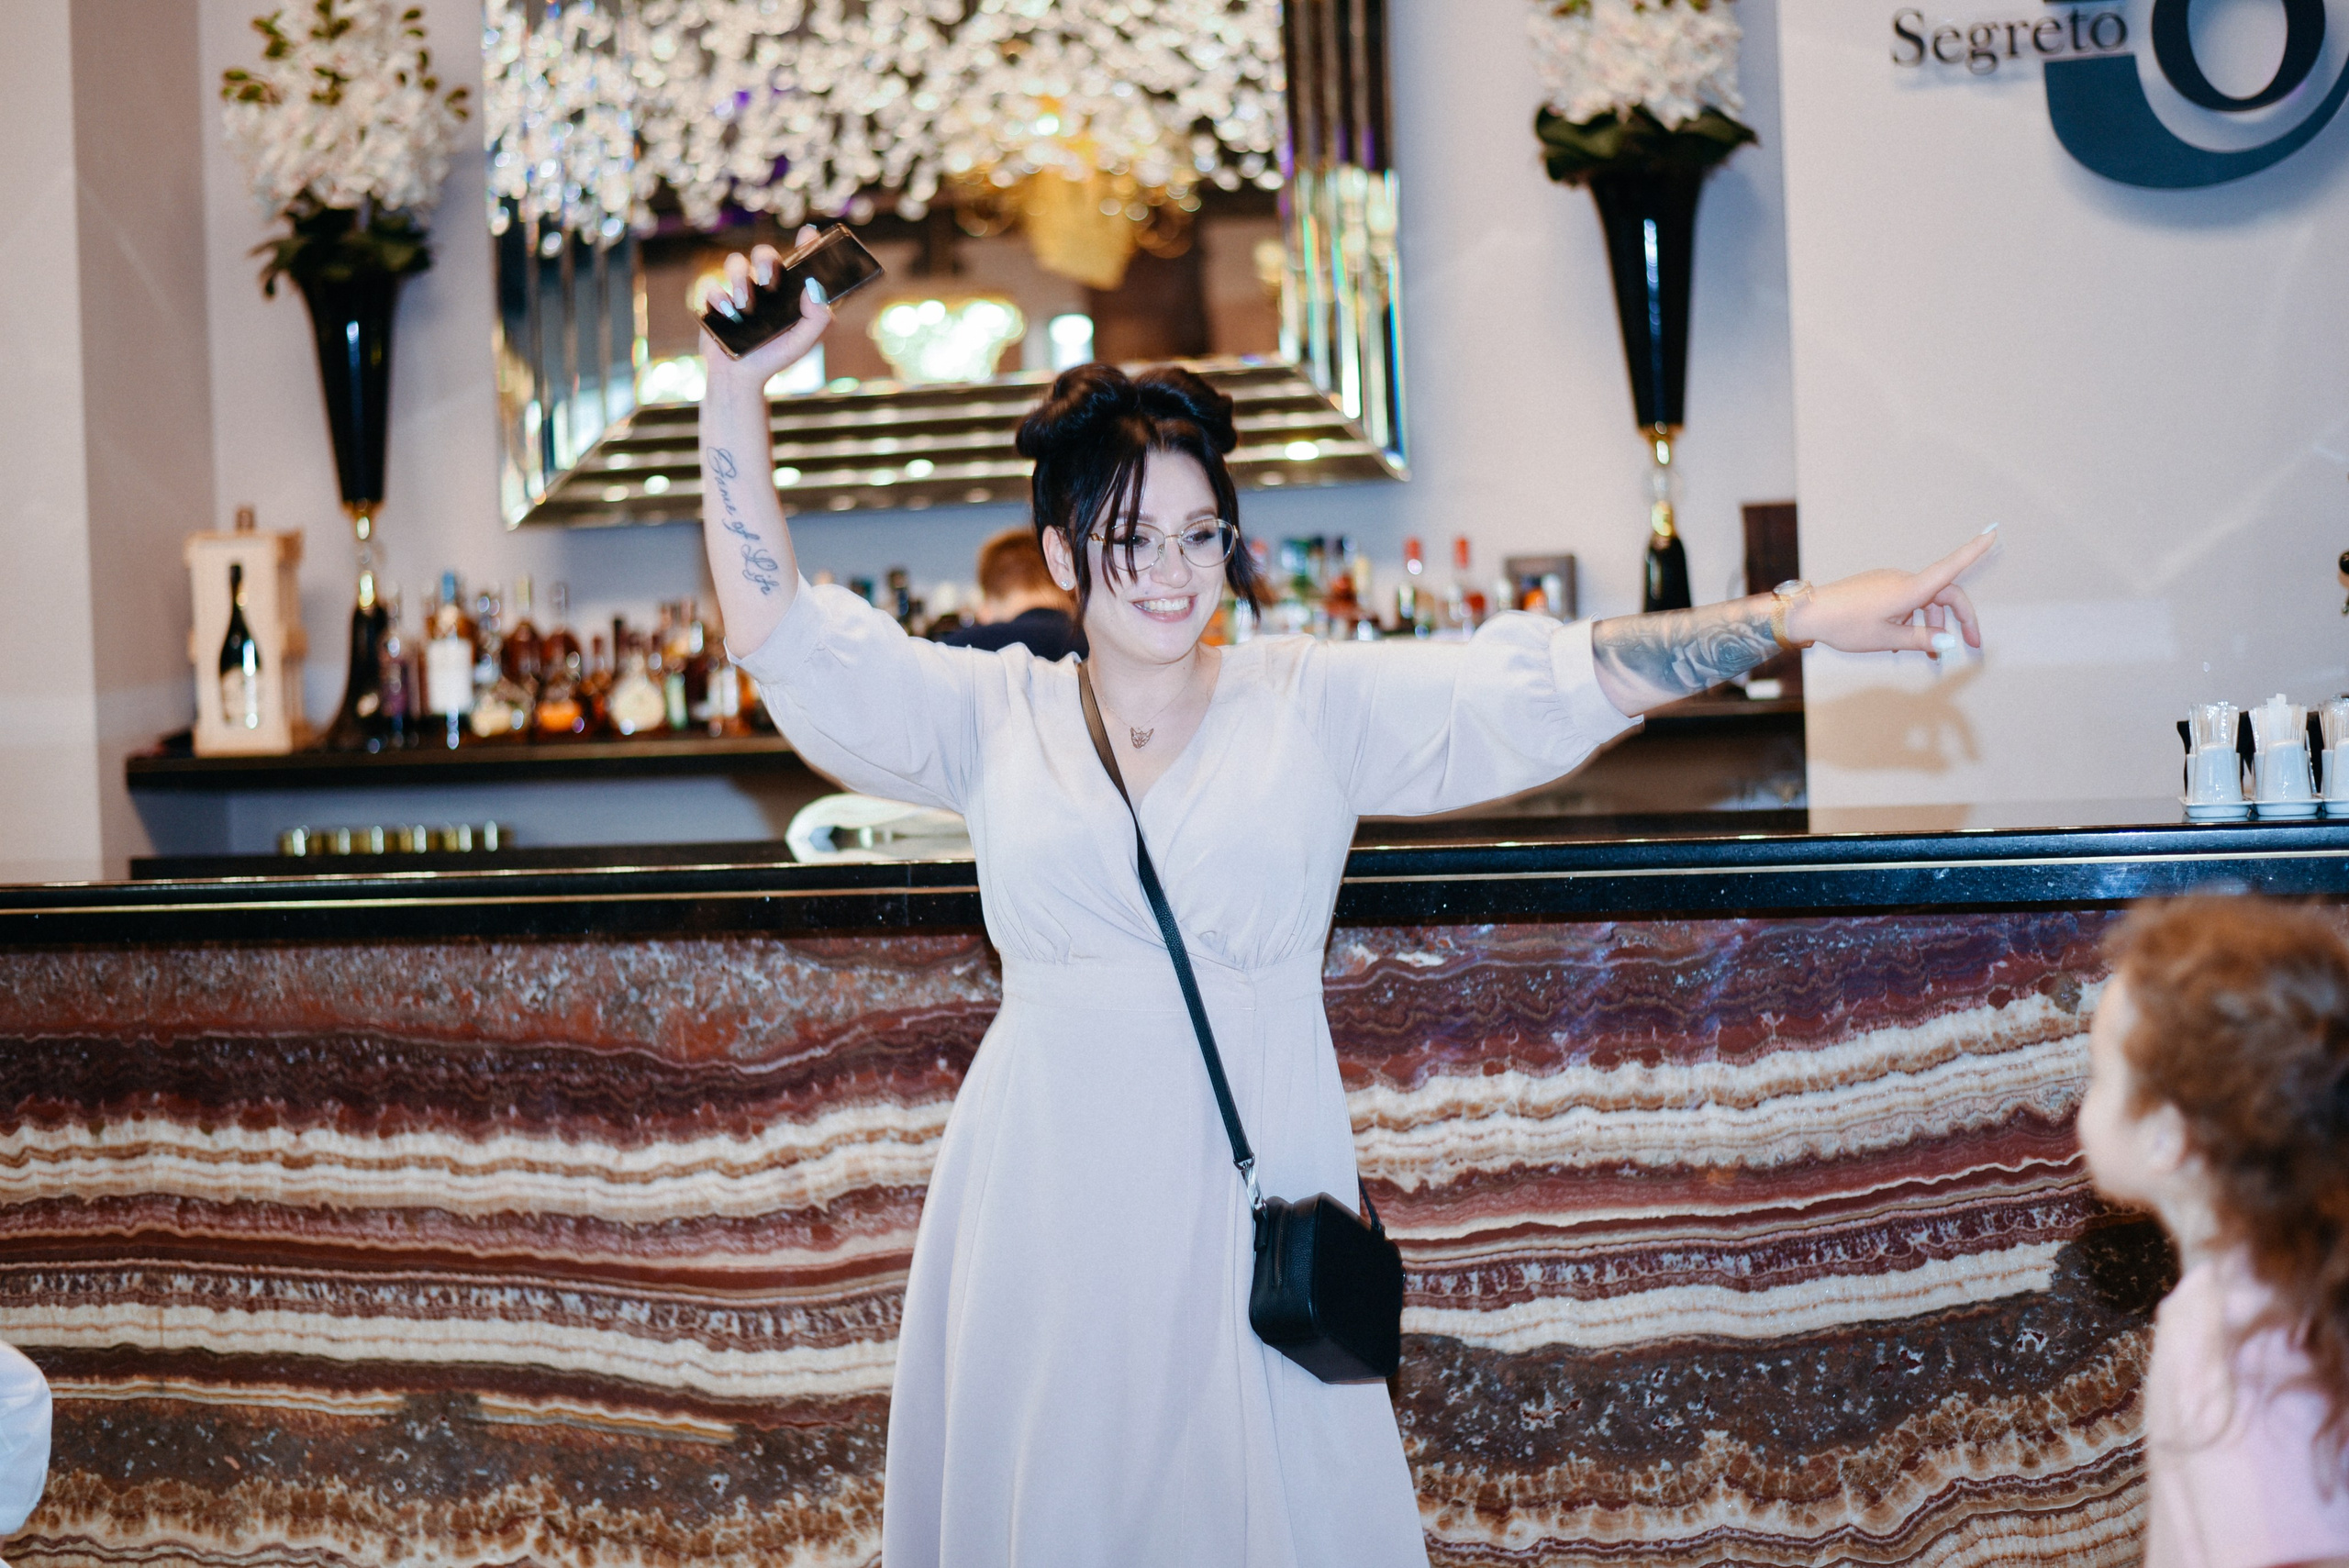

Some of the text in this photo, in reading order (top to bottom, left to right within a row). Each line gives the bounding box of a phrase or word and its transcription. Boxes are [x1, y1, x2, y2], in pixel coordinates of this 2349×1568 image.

[1890, 7, 2129, 75] Segreto
[721, 518, 761, 541] of
[740, 543, 780, 595] Life
